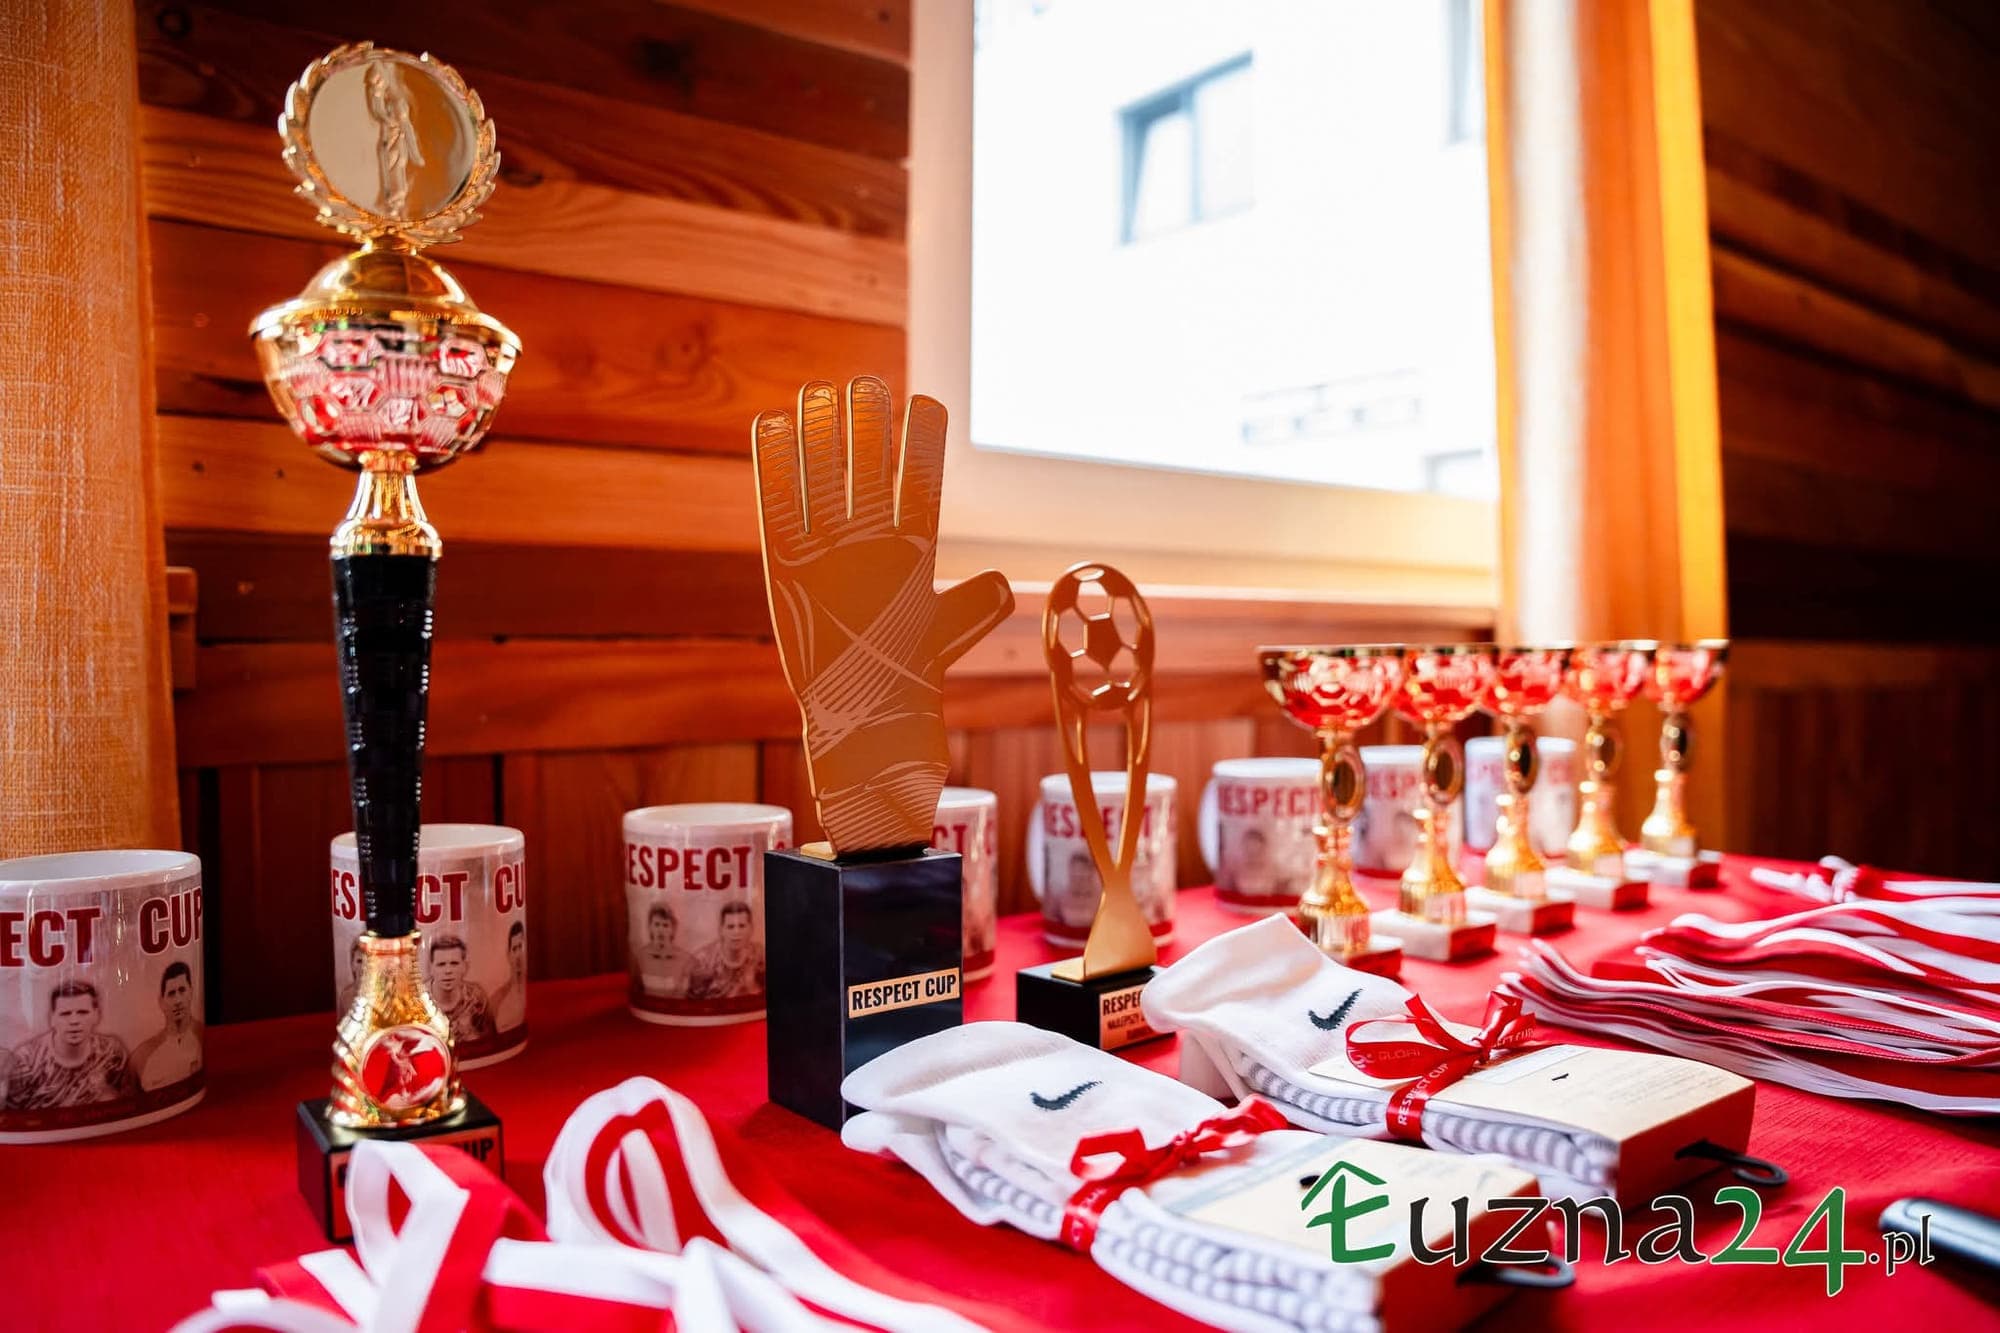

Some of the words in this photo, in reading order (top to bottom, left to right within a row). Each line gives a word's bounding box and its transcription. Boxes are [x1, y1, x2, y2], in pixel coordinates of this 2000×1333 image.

[852, 981, 921, 1011] RESPECT
[925, 974, 957, 997] CUP
[1398, 1076, 1431, 1125] RESPECT
